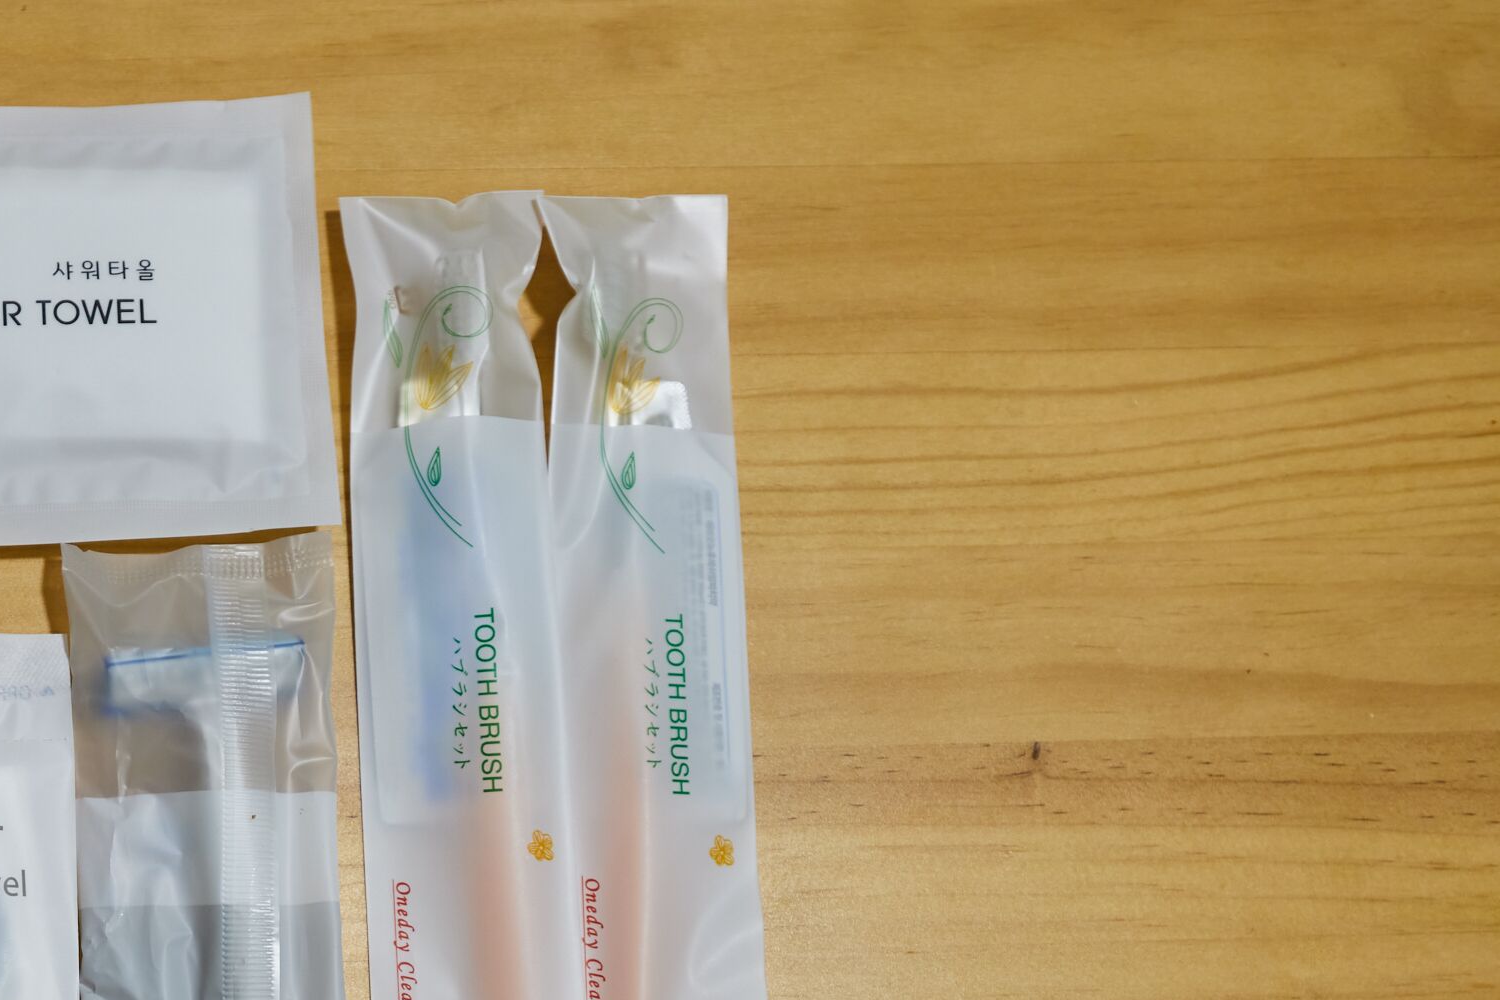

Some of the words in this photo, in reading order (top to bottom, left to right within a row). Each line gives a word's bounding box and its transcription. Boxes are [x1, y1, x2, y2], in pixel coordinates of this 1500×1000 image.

[36, 299, 158, 326] TOWEL
[52, 259, 155, 281] 샤워타올
[474, 607, 498, 696] TOOTH
[664, 613, 687, 700] TOOTH
[451, 637, 471, 769] ハブラシセット
[644, 637, 662, 769] ハブラシセット
[478, 704, 503, 793] BRUSH
[669, 708, 690, 796] BRUSH
[393, 881, 415, 952] Oneday
[582, 878, 604, 950] Oneday
